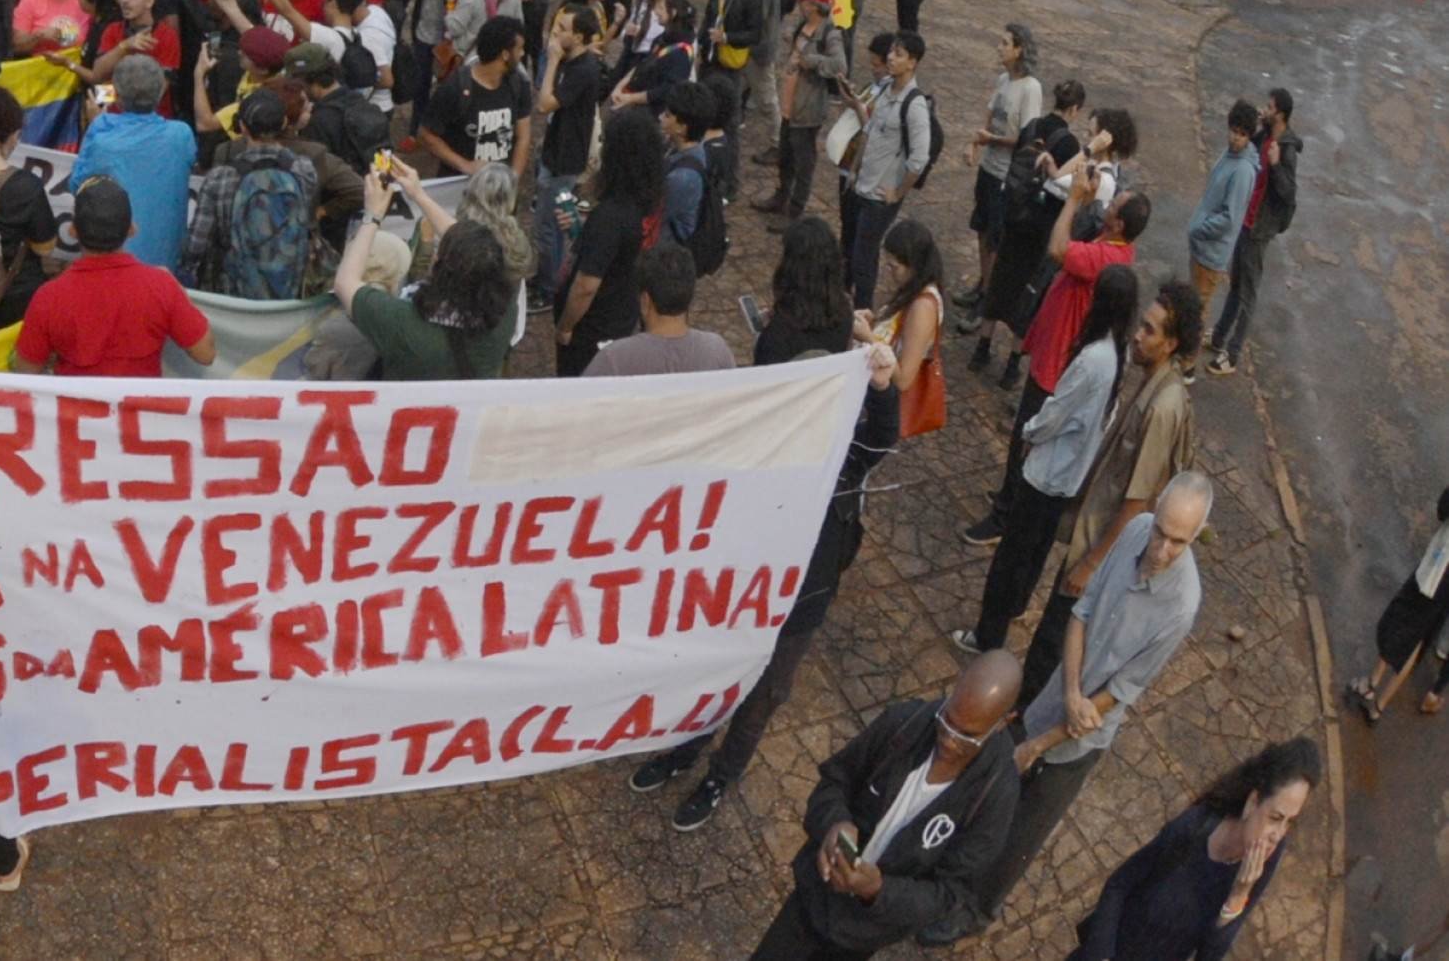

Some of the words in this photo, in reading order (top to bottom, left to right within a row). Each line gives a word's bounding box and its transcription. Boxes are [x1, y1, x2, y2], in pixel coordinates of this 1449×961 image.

[22, 539, 104, 592] NA
[113, 479, 728, 606] VENEZUELA!
[13, 648, 76, 680] DA
[77, 586, 465, 694] AMÉRICA
[480, 565, 802, 658] LATINA!
